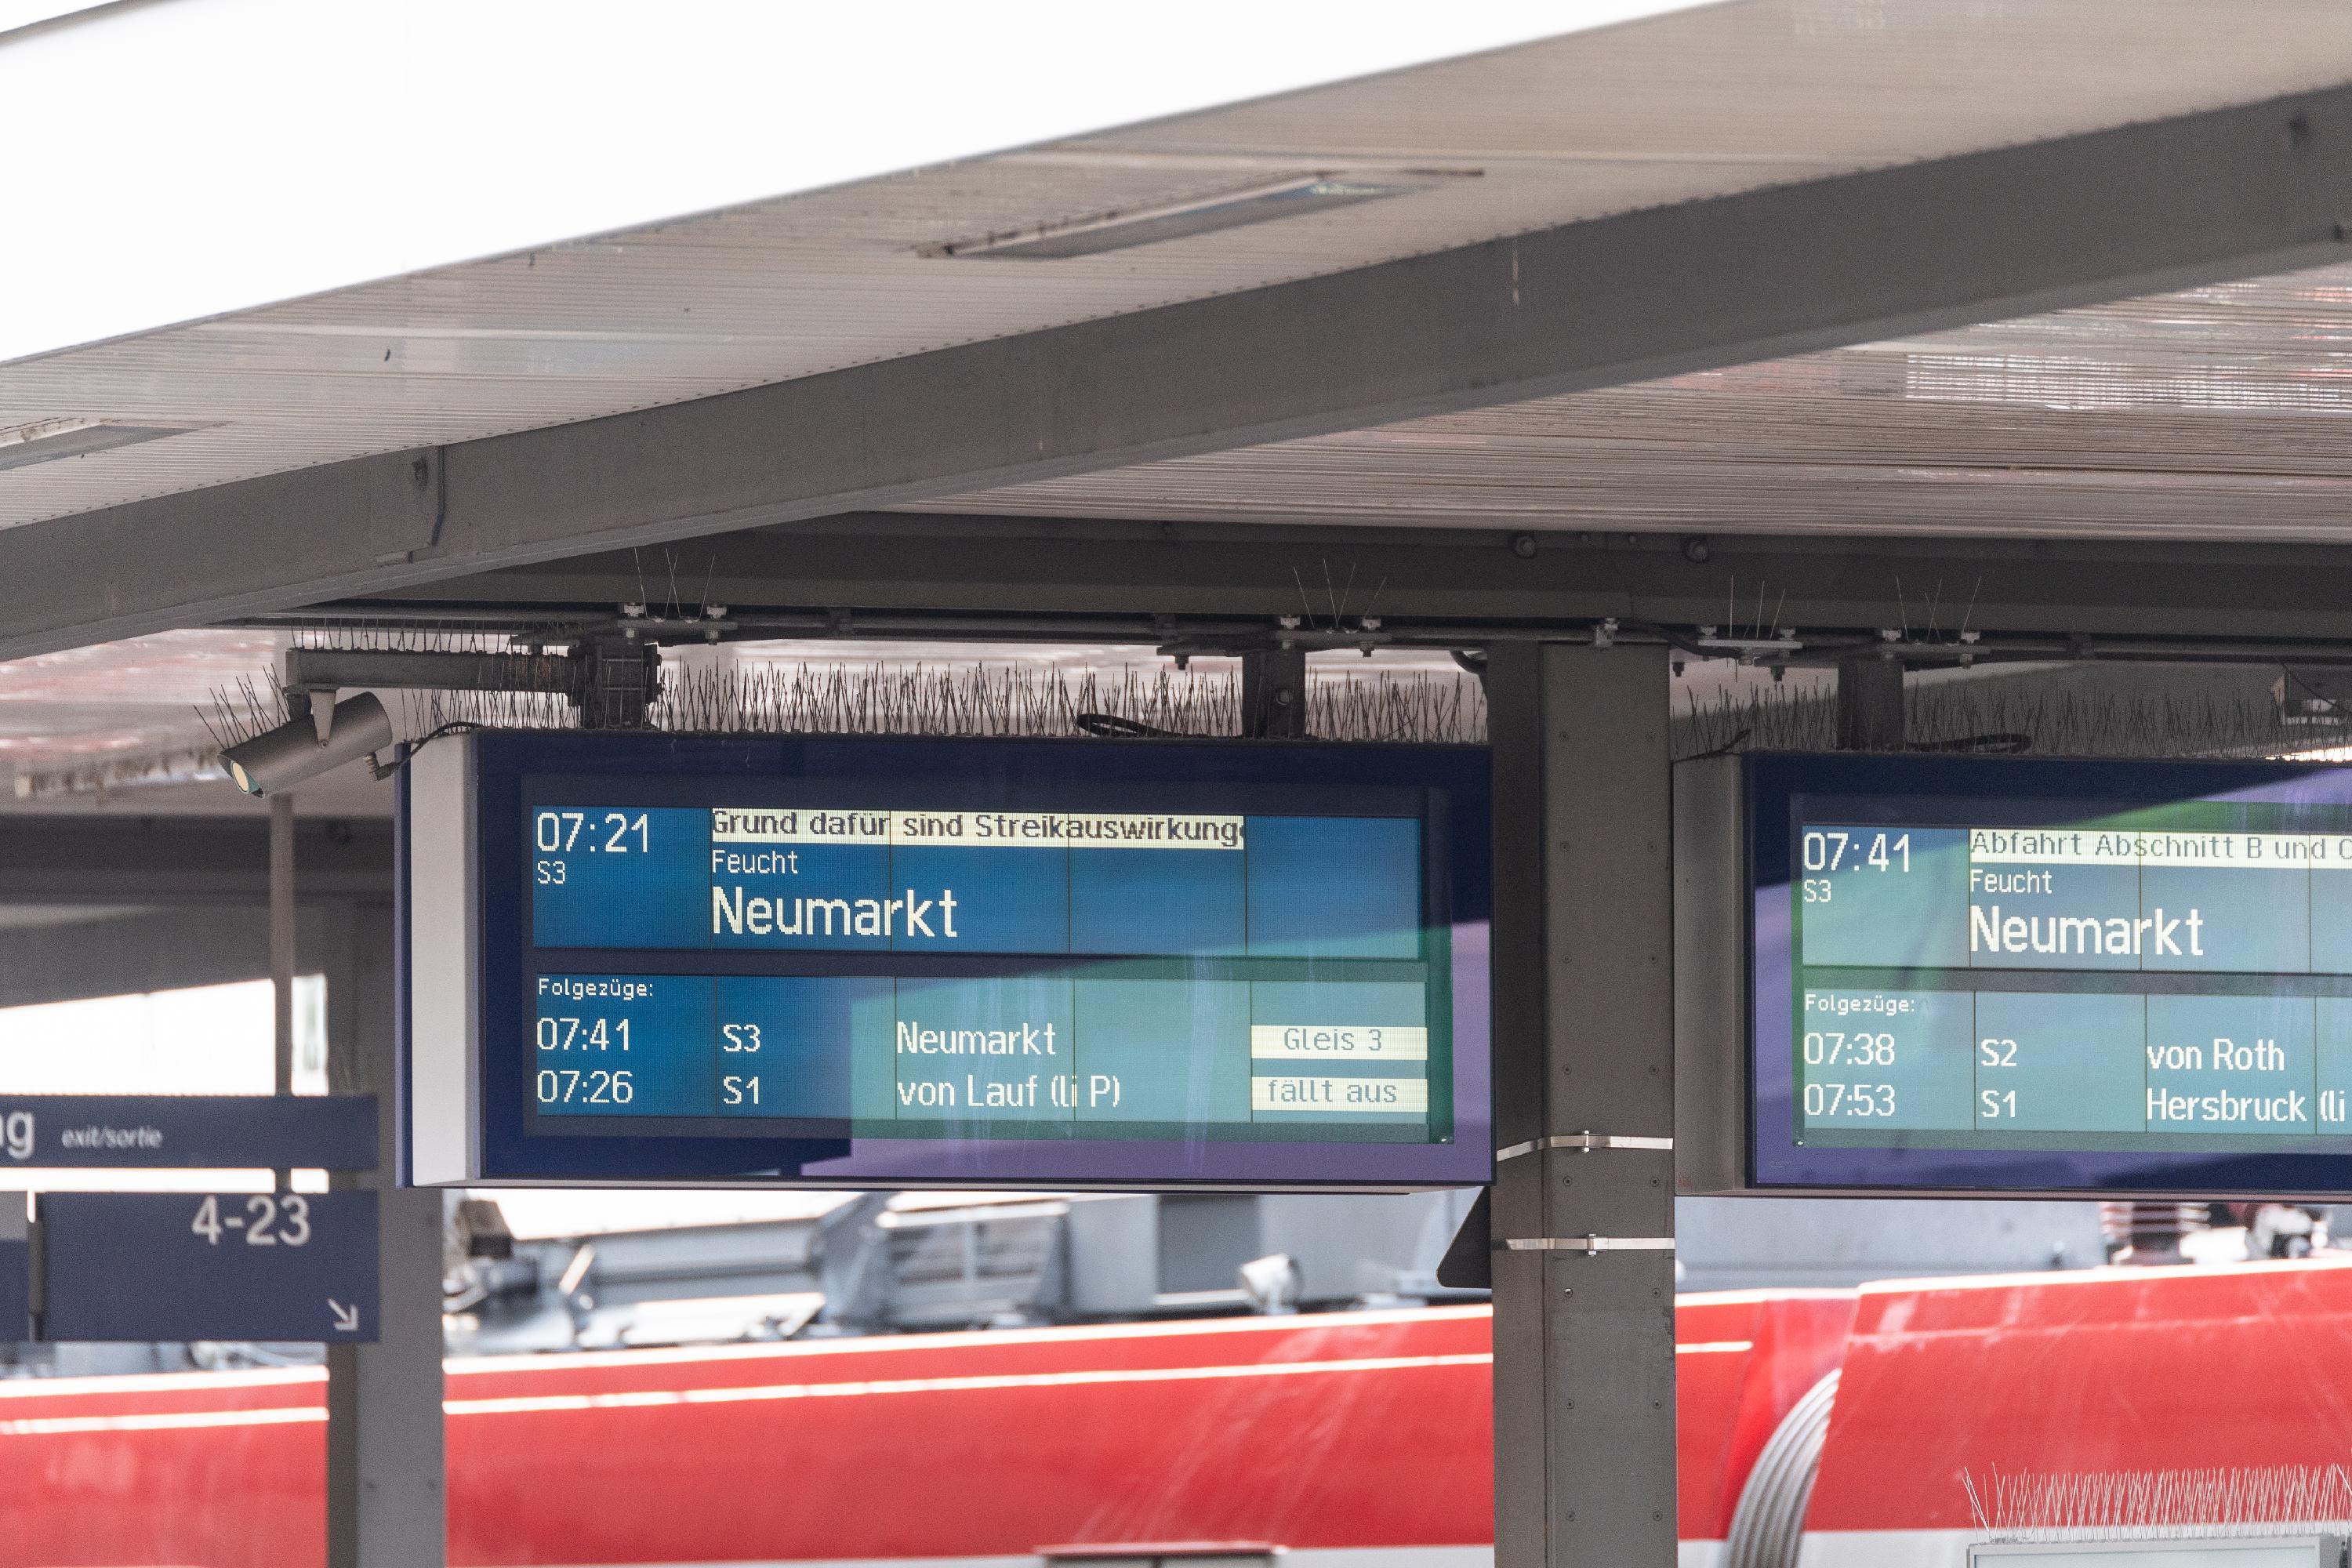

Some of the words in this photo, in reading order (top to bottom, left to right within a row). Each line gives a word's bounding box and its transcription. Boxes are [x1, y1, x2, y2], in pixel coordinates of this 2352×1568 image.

[537, 812, 648, 853] 07:21
[712, 811, 797, 834] Grund
[809, 811, 891, 836] dafür
[902, 814, 964, 837] sind
[975, 815, 1244, 848] Streikauswirkung
[1970, 831, 2082, 855] Abfahrt
[2095, 832, 2238, 858] Abschnitt
[2247, 837, 2262, 858] B
[2274, 838, 2326, 859] und
[712, 849, 798, 874] Feucht
[1804, 832, 1910, 873] 07:41
[537, 860, 565, 884] S3
[1803, 879, 1831, 902] S3
[1969, 869, 2053, 895] Feucht
[713, 886, 957, 938] Neumarkt
[1970, 905, 2204, 956] Neumarkt
[539, 978, 653, 1000] Folgezüge:
[1805, 993, 1915, 1014] Folgezüge:
[536, 1017, 629, 1051] 07:41
[723, 1024, 760, 1052] S3
[897, 1021, 1056, 1055] Neumarkt
[1283, 1028, 1355, 1051] Gleis
[1368, 1029, 1382, 1051] 3
[1804, 1033, 1895, 1065] 07:38
[1980, 1039, 2017, 1067] S2
[2147, 1046, 2202, 1070] von
[2213, 1038, 2285, 1071] Roth
[537, 1069, 633, 1103] 07:26
[723, 1076, 759, 1105] S1
[897, 1082, 955, 1106] von
[967, 1074, 1038, 1107] Lauf
[1091, 1075, 1120, 1108] P)
[1269, 1080, 1333, 1102] fällt
[1346, 1084, 1397, 1103] aus
[1804, 1083, 1896, 1116] 07:53
[1981, 1090, 2016, 1118] S1
[2147, 1087, 2307, 1122] Hersbruck
[61, 1126, 162, 1148] exit/sortie
[191, 1194, 310, 1246] 4-23
